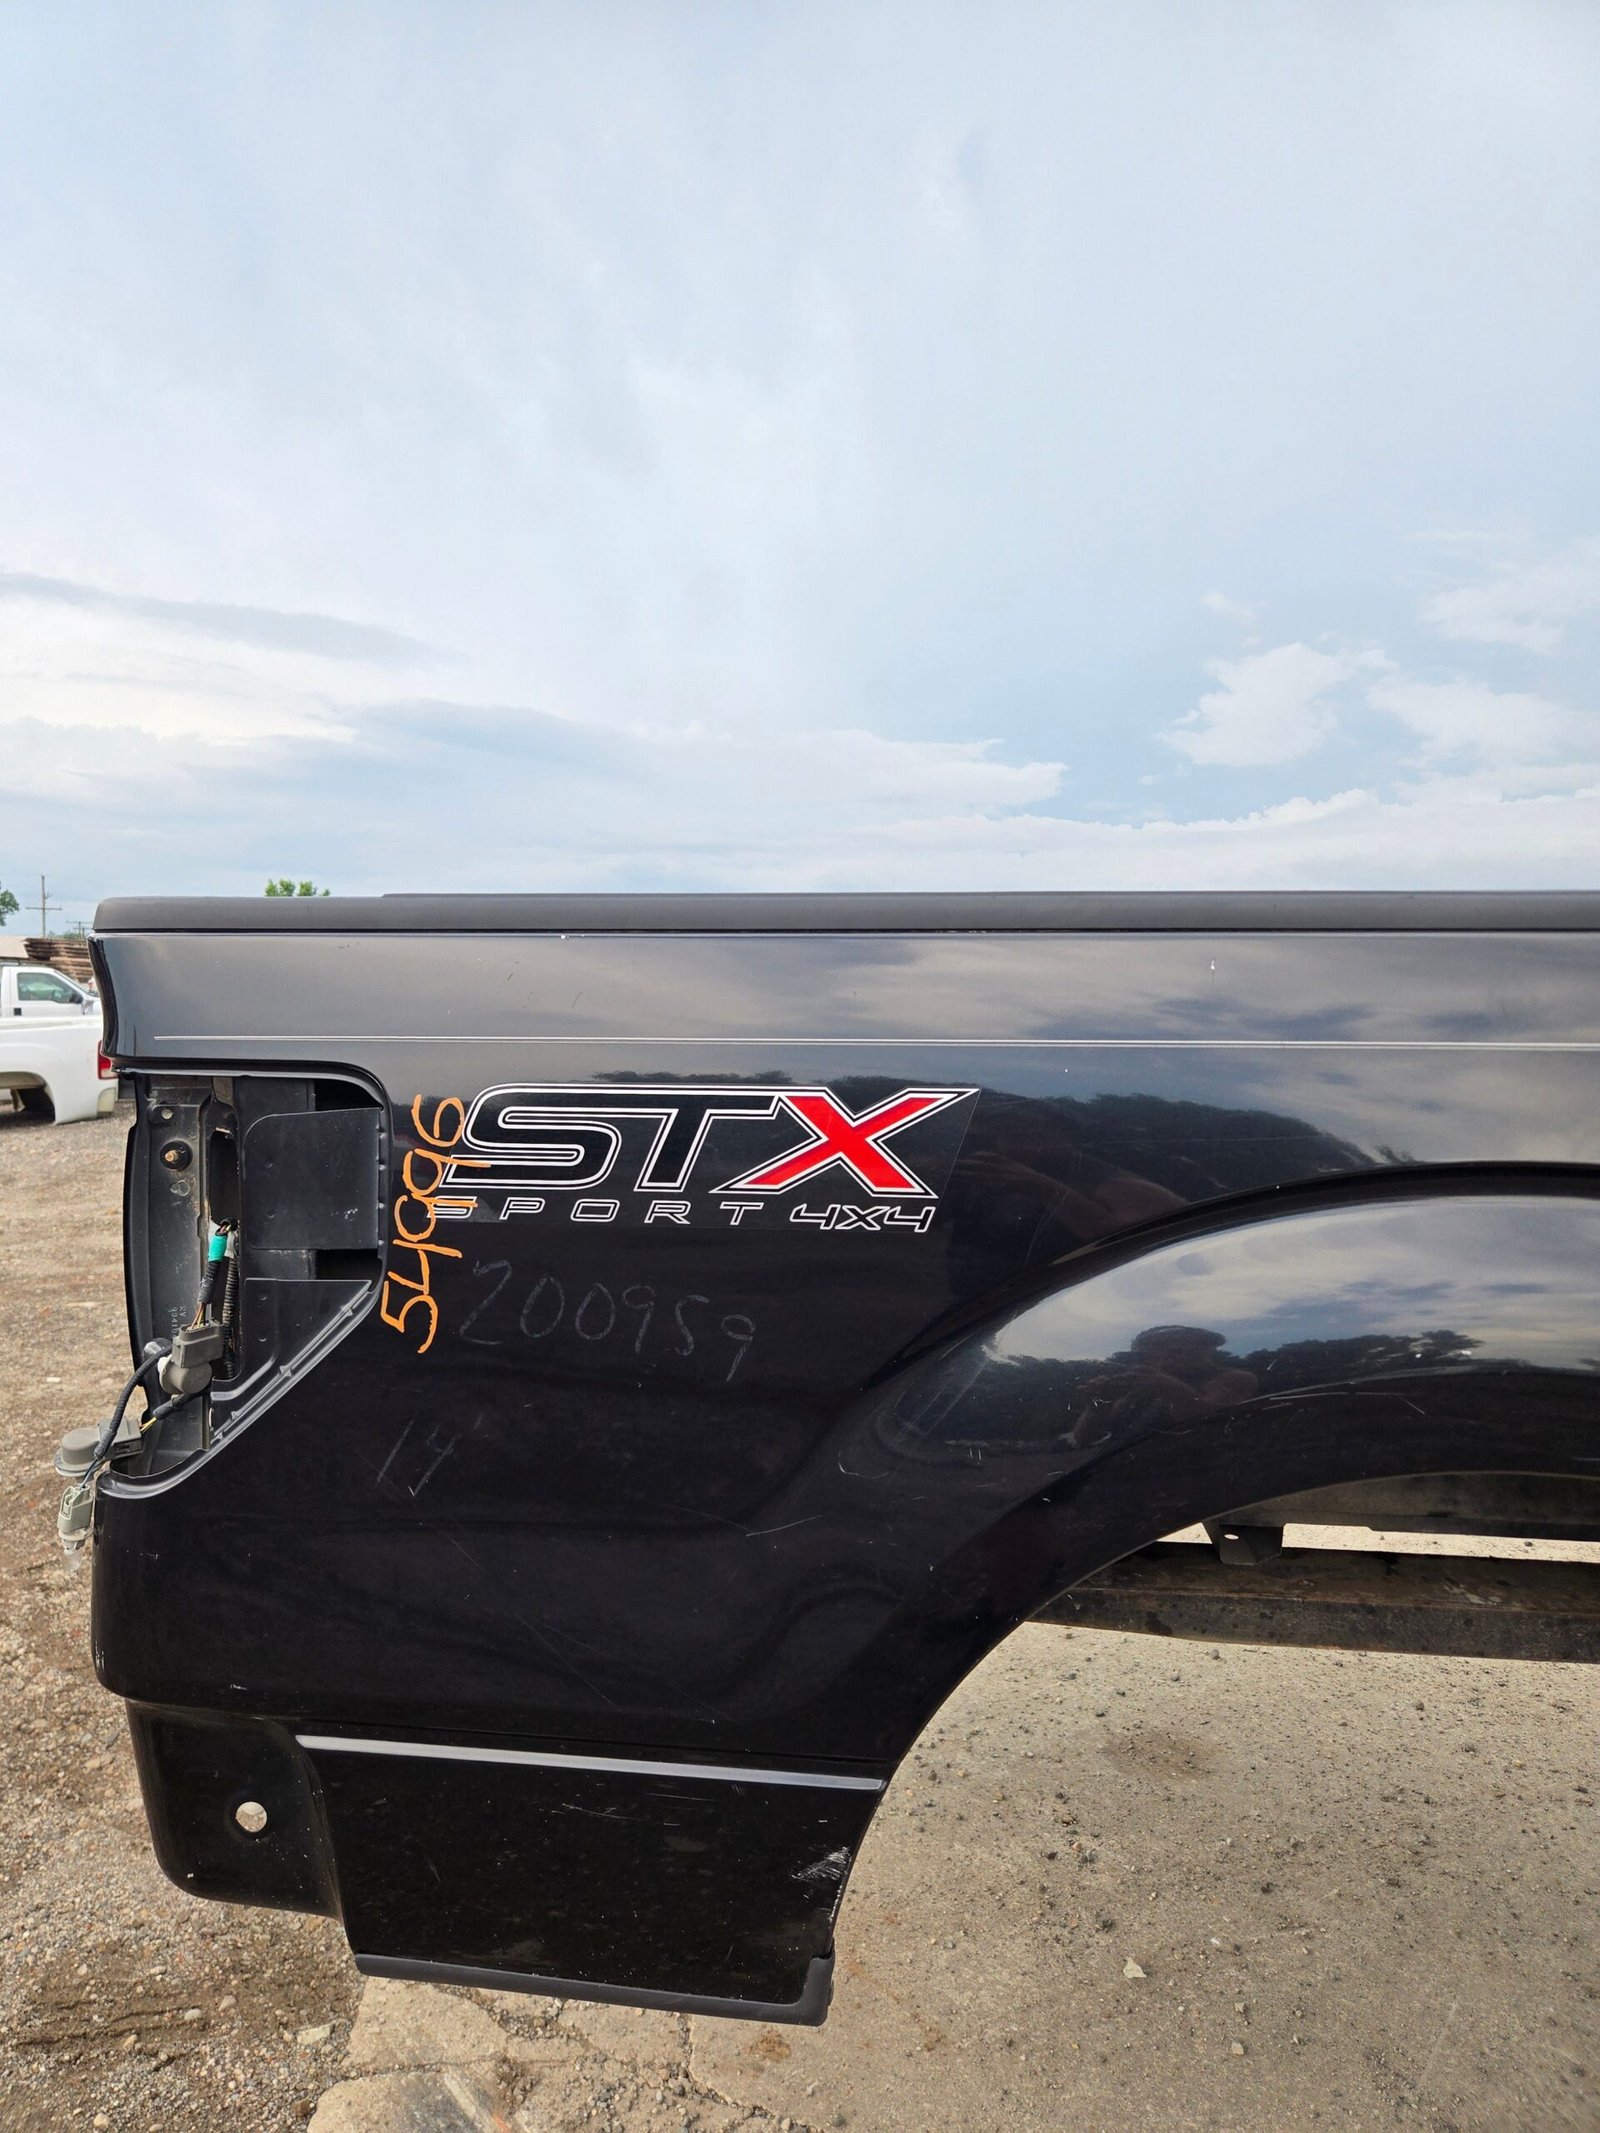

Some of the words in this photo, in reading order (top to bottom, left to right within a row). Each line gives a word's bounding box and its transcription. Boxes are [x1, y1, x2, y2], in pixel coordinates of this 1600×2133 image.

[439, 1083, 980, 1199] STX
[427, 1196, 764, 1226] SPORT
[790, 1203, 936, 1233] 4X4
